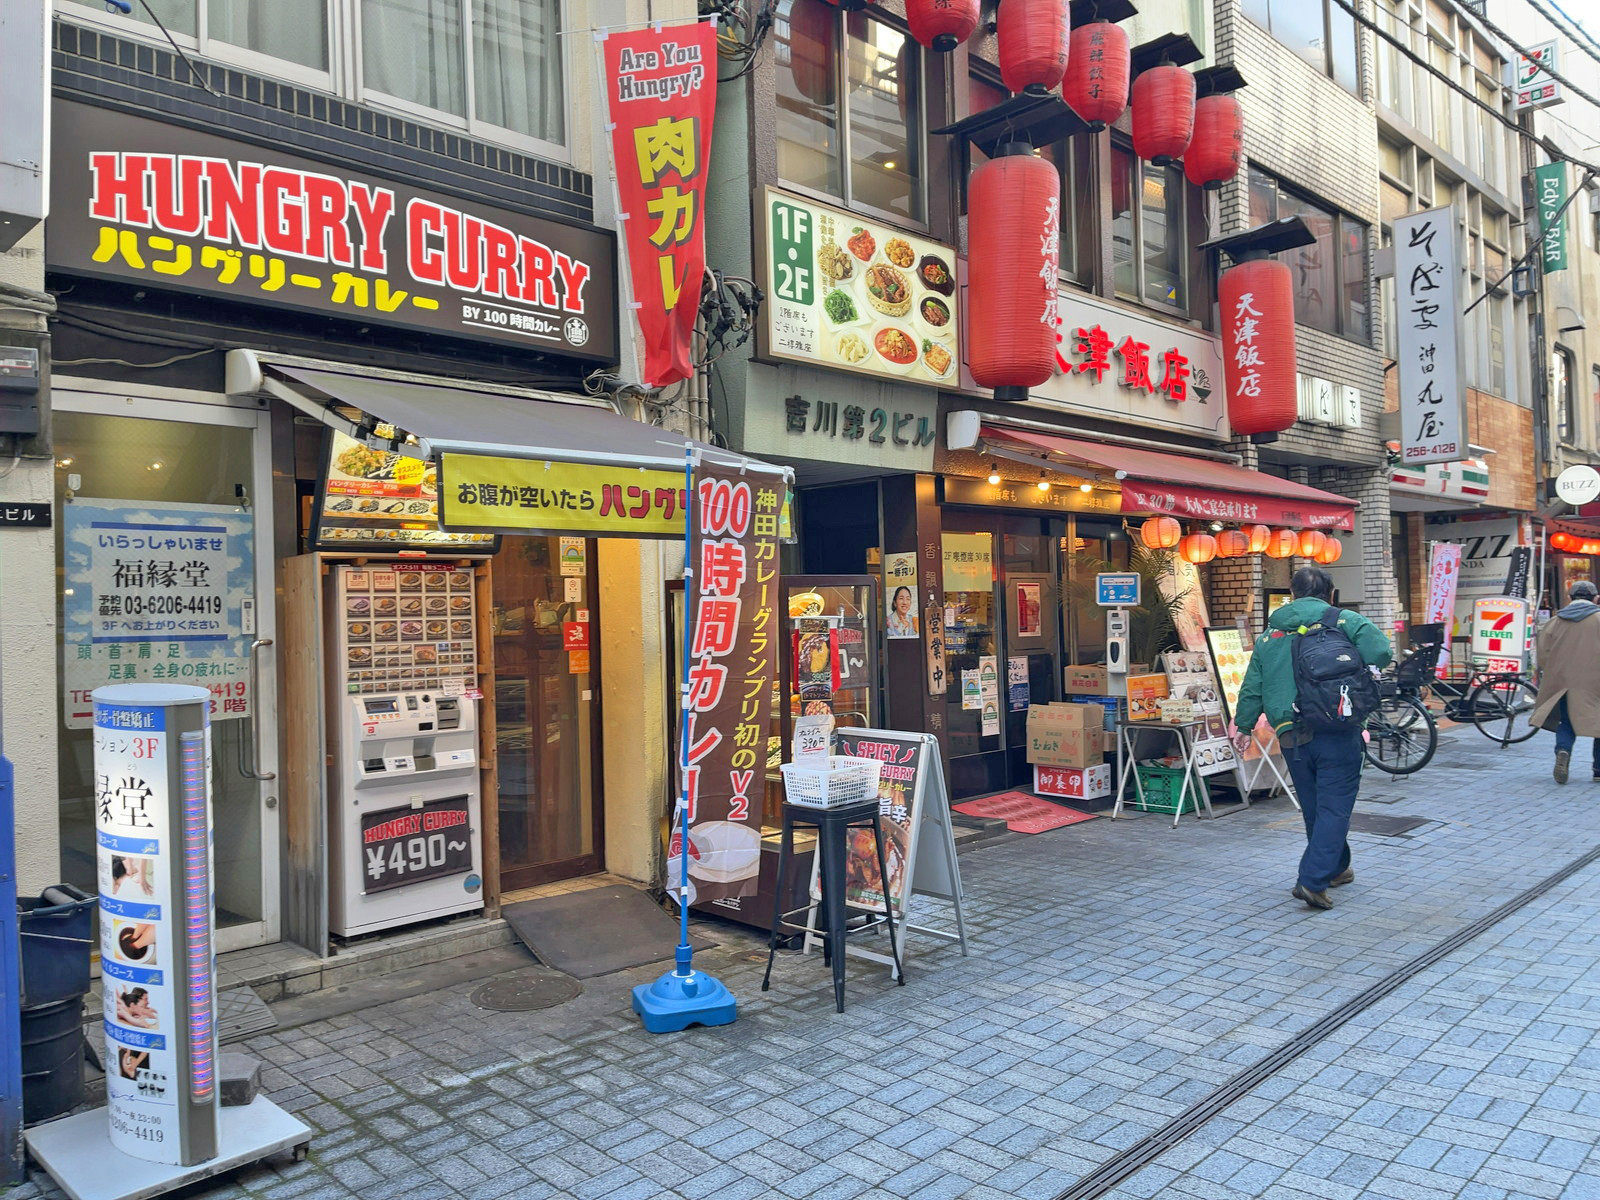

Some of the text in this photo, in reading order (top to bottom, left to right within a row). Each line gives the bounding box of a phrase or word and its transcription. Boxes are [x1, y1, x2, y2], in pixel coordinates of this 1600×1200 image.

[620, 43, 700, 72] Are You
[619, 65, 703, 101] Hungry?
[89, 151, 590, 313] HUNGRY CURRY
[776, 206, 808, 245] 1F
[1546, 227, 1560, 262] BAR
[92, 226, 440, 312] ハングリーカレー
[777, 262, 809, 300] 2F
[462, 305, 560, 333] BY 100 時間カレー
[1234, 293, 1264, 398] 天津飯店
[785, 395, 936, 447] 吉川第2ビル
[1416, 380, 1444, 442] 丸屋
[458, 483, 595, 510] お腹が空いたら
[1562, 479, 1595, 490] BUZZ
[0, 508, 35, 521] ビル
[99, 534, 223, 551] いらっしゃいませ
[112, 559, 210, 588] 福縁堂
[1461, 560, 1485, 568] NDA
[99, 595, 121, 605] 予約
[99, 606, 121, 615] 優先
[125, 595, 222, 615] 03-6206-4419
[102, 620, 219, 630] 3F へお上がりください
[1481, 611, 1514, 651] 7
[929, 613, 943, 689] 営業中
[70, 690, 92, 703] TE
[133, 737, 159, 759] 3F
[856, 741, 900, 763] SPICY
[880, 765, 915, 781] CURRY
[364, 810, 467, 844] HUNGRY CURRY
